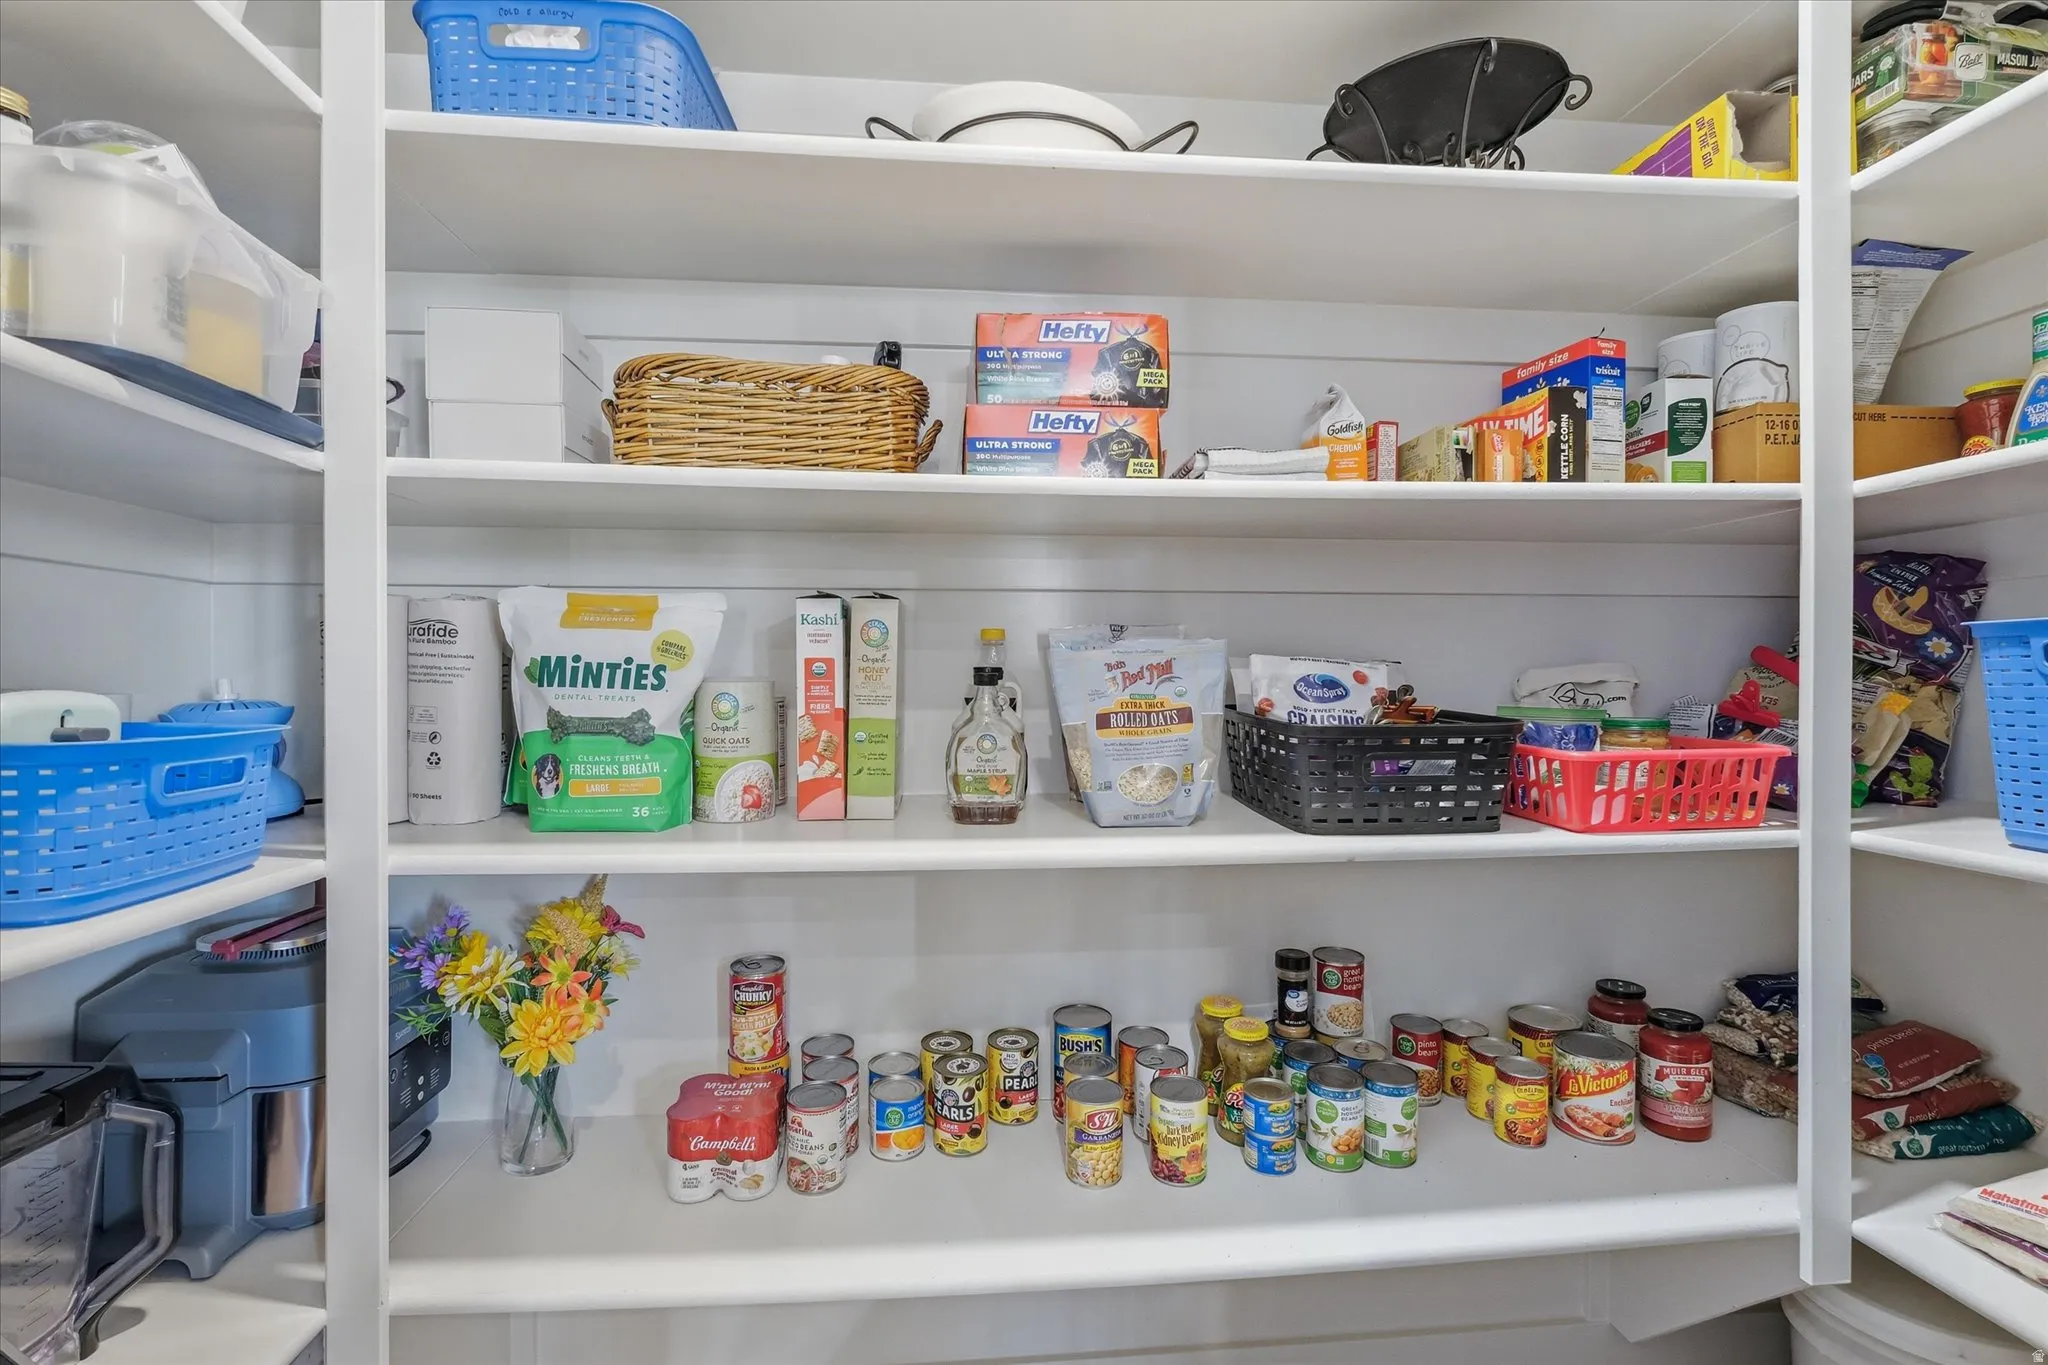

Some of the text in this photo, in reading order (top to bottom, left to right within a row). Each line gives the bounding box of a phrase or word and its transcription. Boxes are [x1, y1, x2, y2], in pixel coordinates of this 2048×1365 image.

[1958, 54, 1983, 68] Ball
[1996, 52, 2027, 66] MASON
[1695, 116, 1706, 132] ON
[1706, 118, 1716, 140] GREAT
[1698, 131, 1709, 151] THE
[1042, 323, 1106, 343] Hefty
[1597, 341, 1617, 350] family
[1022, 351, 1063, 359] STRONG
[1517, 352, 1568, 379] family size
[1595, 367, 1620, 376] triscuit
[987, 394, 1002, 403] 50
[1032, 413, 1095, 432] Hefty
[1504, 405, 1544, 439] TIME
[1869, 413, 1886, 422] HERE
[1327, 421, 1364, 436] Goldfish
[1765, 420, 1790, 430] 12-16
[1764, 434, 1790, 445] P.E.T.
[1329, 443, 1362, 452] CHEDDAR
[1561, 414, 1569, 480] KETTLE CORN
[800, 613, 838, 626] Kashi
[408, 623, 458, 638] urafide
[661, 640, 686, 652] COMPARE
[861, 653, 887, 664] Organic
[538, 654, 667, 692] MiNTiES
[858, 666, 890, 674] HONEY
[1120, 657, 1174, 693] Red Mill
[1296, 682, 1346, 698] Ocean Spray
[1120, 700, 1165, 710] EXTRA THICK
[1762, 696, 1779, 706] SEA
[1110, 710, 1179, 728] ROLLED OATS
[711, 722, 739, 733] Organic
[1146, 727, 1172, 735] GRAIN
[570, 762, 660, 775] FRESHENS BREATH
[586, 784, 610, 792] LARGE
[632, 807, 649, 817] 36
[1343, 969, 1360, 977] great
[734, 989, 772, 1002] CHUNKY
[1060, 1037, 1102, 1053] BUSH'S
[1418, 1040, 1436, 1050] pinto
[1867, 1036, 1894, 1052] pinto
[1418, 1049, 1438, 1057] beans
[1663, 1067, 1687, 1075] MUIR
[1566, 1069, 1628, 1095] La Victoria
[788, 1123, 813, 1137] osarita
[940, 1122, 959, 1130] LARGE
[1166, 1123, 1191, 1136] Dark Red
[689, 1136, 756, 1151] Campbell's
[1159, 1132, 1201, 1147] Kidney Beans
[1938, 1145, 1957, 1154] great
[1980, 1188, 2048, 1215] Mahatma
